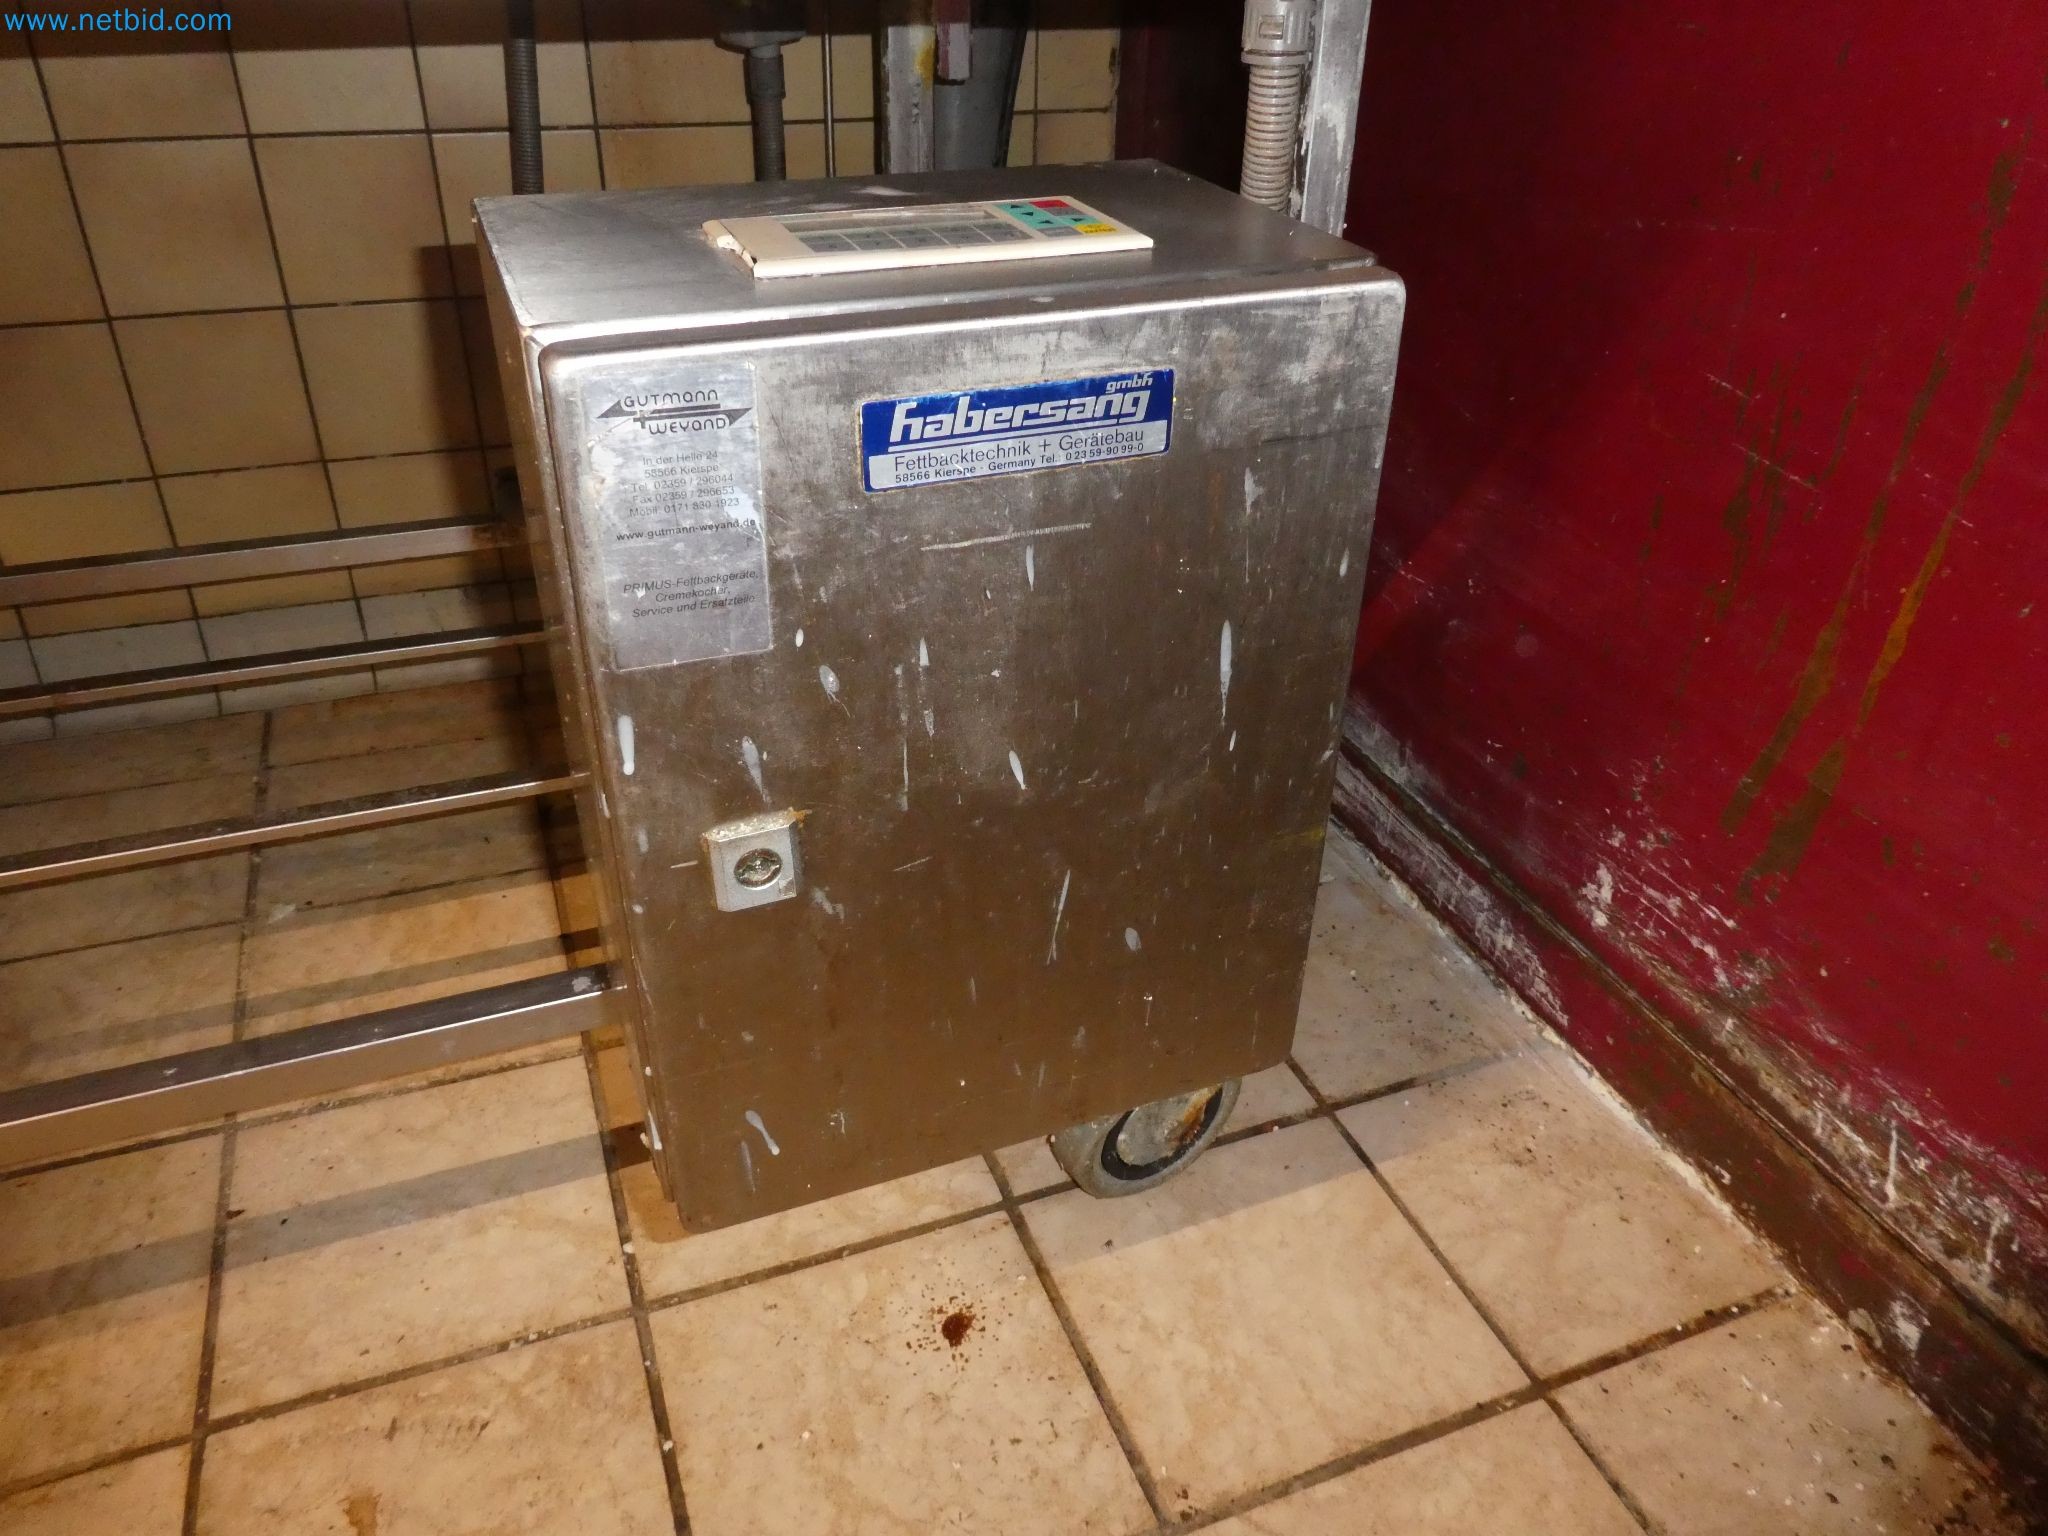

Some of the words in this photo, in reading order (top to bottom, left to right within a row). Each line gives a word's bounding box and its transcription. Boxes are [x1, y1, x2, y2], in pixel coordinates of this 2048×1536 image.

[889, 390, 1151, 443] habersang
[643, 456, 653, 466] In
[656, 455, 673, 465] der
[705, 450, 718, 460] 24
[894, 440, 1031, 472] Fettbacktechnik
[1038, 438, 1052, 453] +
[1059, 428, 1144, 452] Gerätebau
[644, 466, 678, 479] 58566
[680, 463, 719, 475] Kierspe
[895, 471, 931, 484] 58566
[934, 465, 977, 478] Kierspe
[988, 457, 1036, 471] Germany
[654, 477, 687, 490] 02359
[696, 473, 734, 486] 296044
[655, 490, 688, 503] 02359
[697, 485, 735, 498] 296653
[663, 502, 689, 514] 0171
[692, 500, 711, 511] 830
[715, 497, 740, 509] 1923
[616, 518, 756, 541] www.gutmann-weyand.de
[632, 605, 673, 618] Service
[677, 601, 697, 613] und
